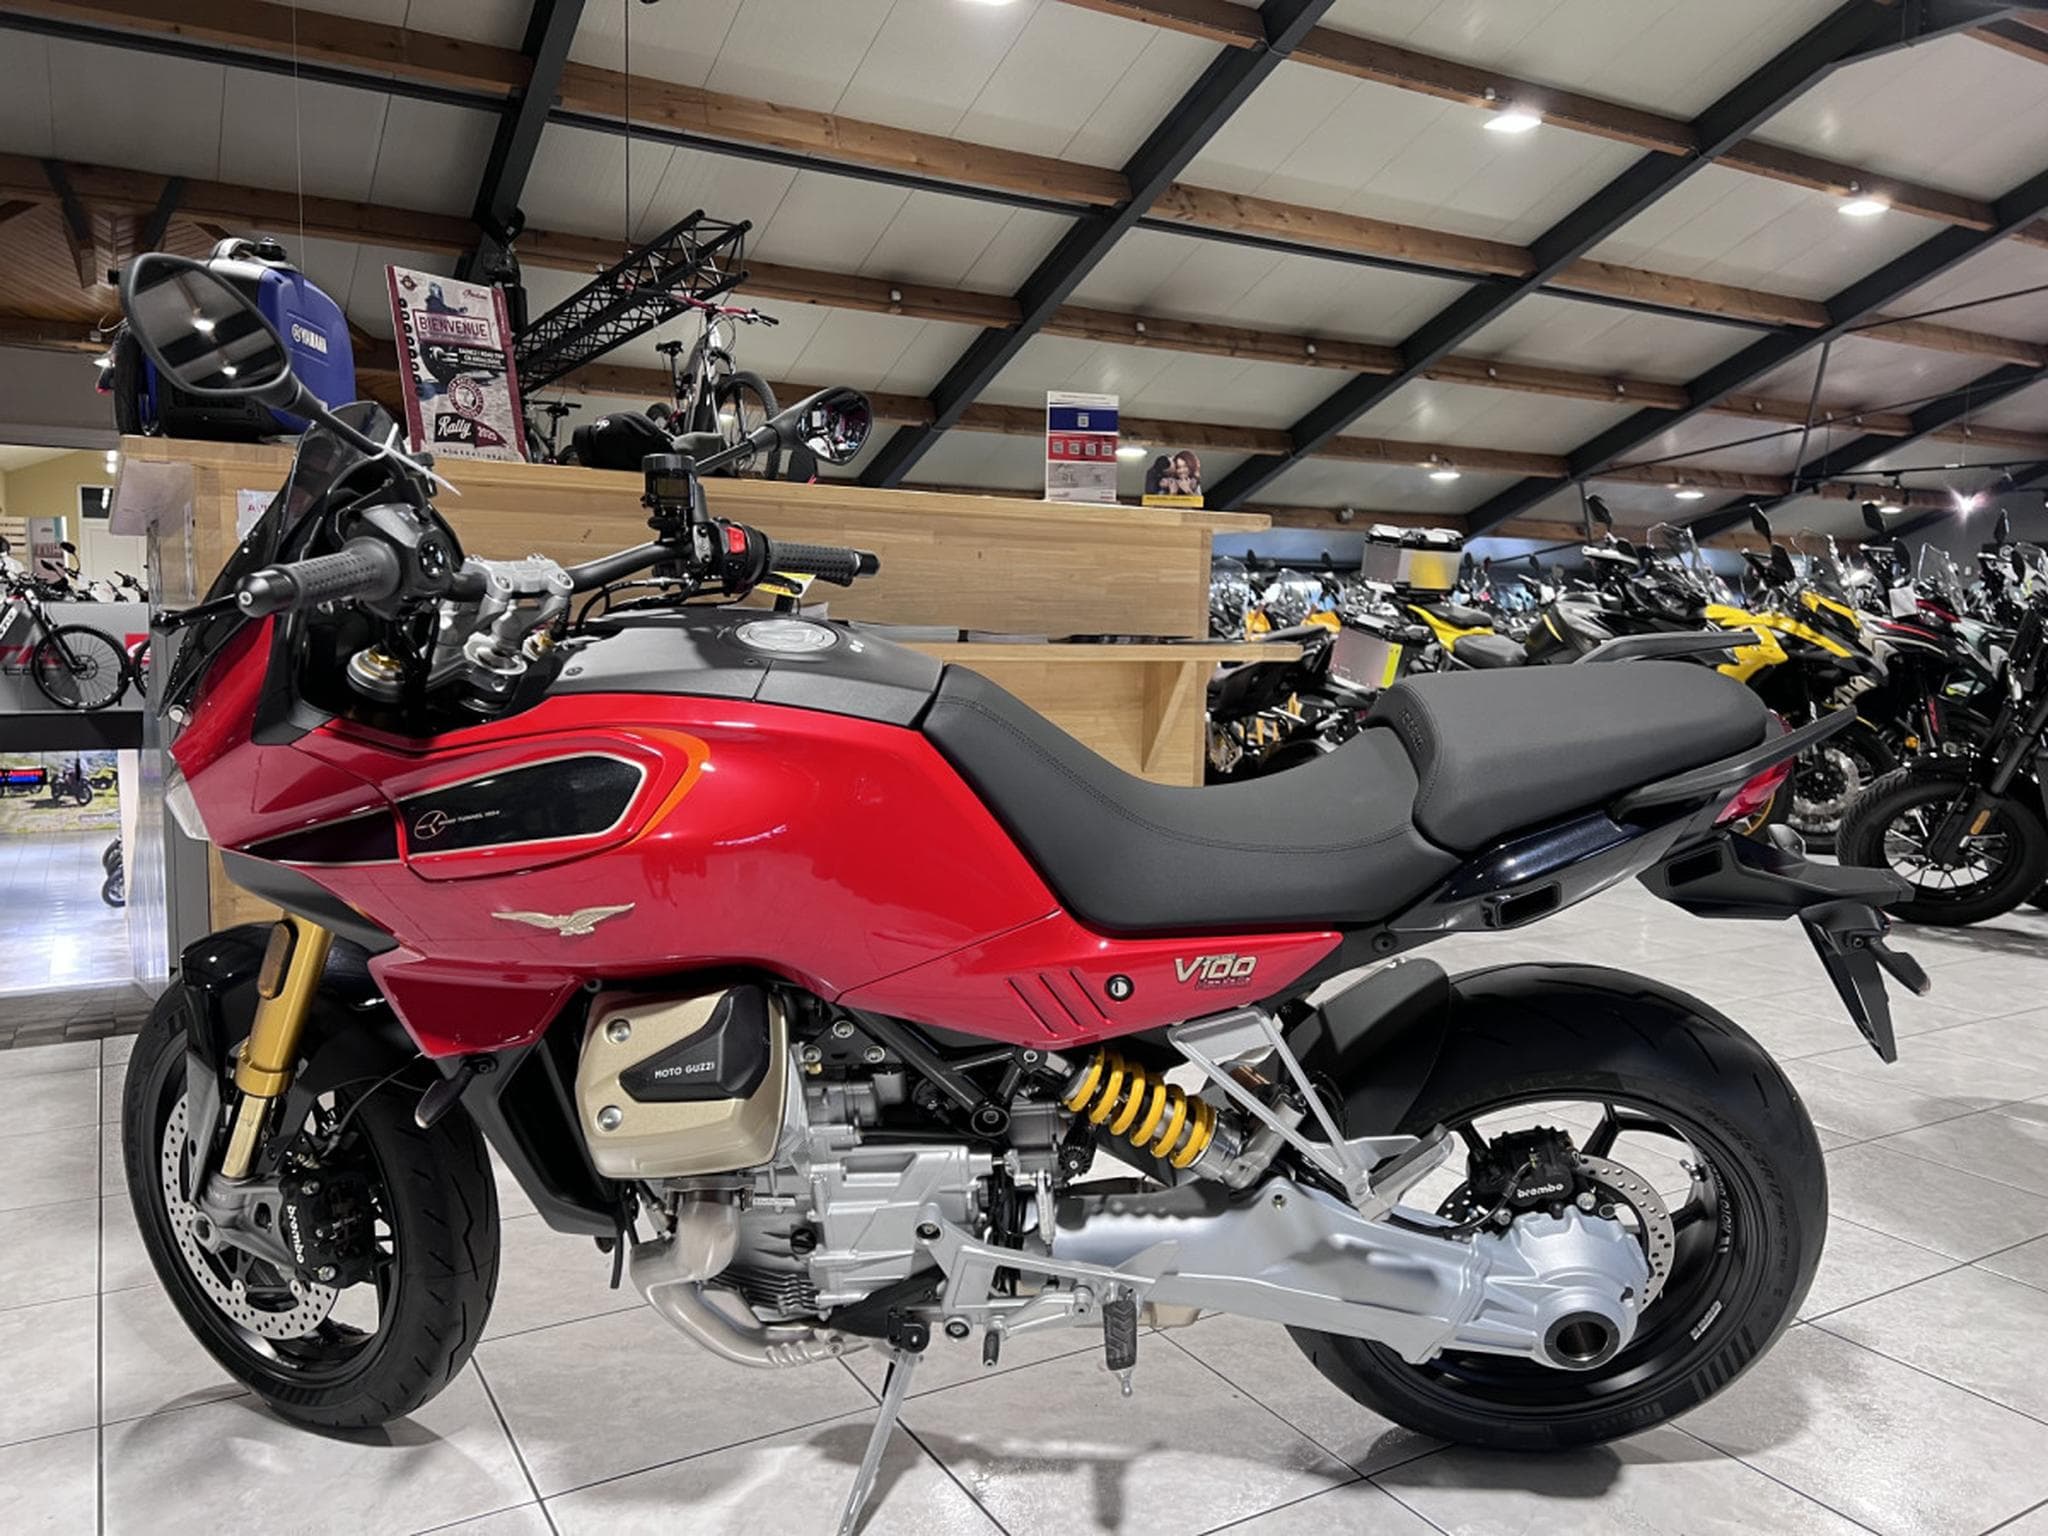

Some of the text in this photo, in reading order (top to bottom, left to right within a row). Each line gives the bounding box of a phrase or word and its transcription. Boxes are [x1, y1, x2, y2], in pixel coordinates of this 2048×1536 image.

[419, 316, 488, 337] BIENVENUE
[438, 416, 472, 439] Rally
[1175, 956, 1257, 982] V100
[654, 1061, 715, 1079] MOTO GUZZI
[1516, 1183, 1564, 1199] brembo
[286, 1204, 305, 1264] brembo
